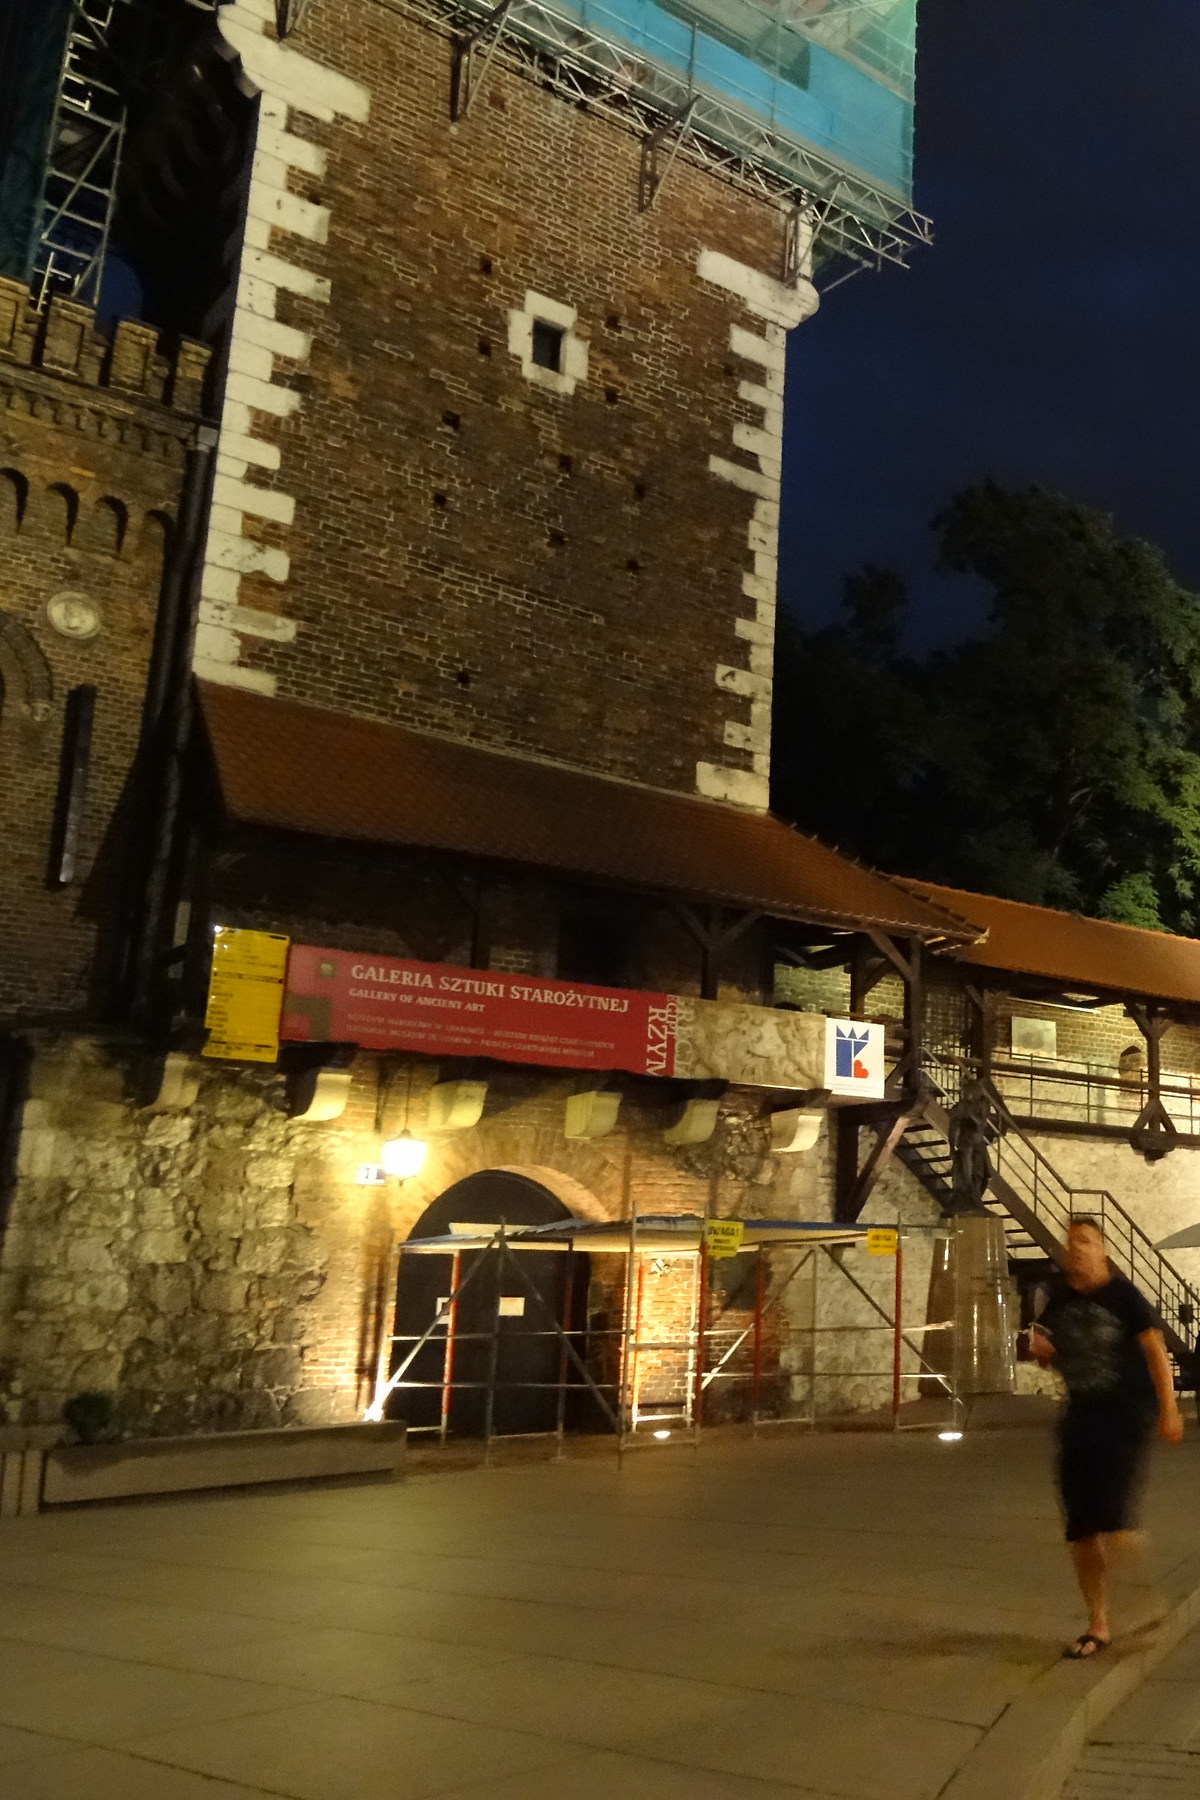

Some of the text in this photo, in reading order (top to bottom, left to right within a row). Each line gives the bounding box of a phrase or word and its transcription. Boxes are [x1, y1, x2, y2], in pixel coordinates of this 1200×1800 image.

[349, 987, 486, 1013] GALLERY OF ANCIENT ART
[351, 965, 629, 1013] GALERIA SZTUKI STAROŻYTNEJ
